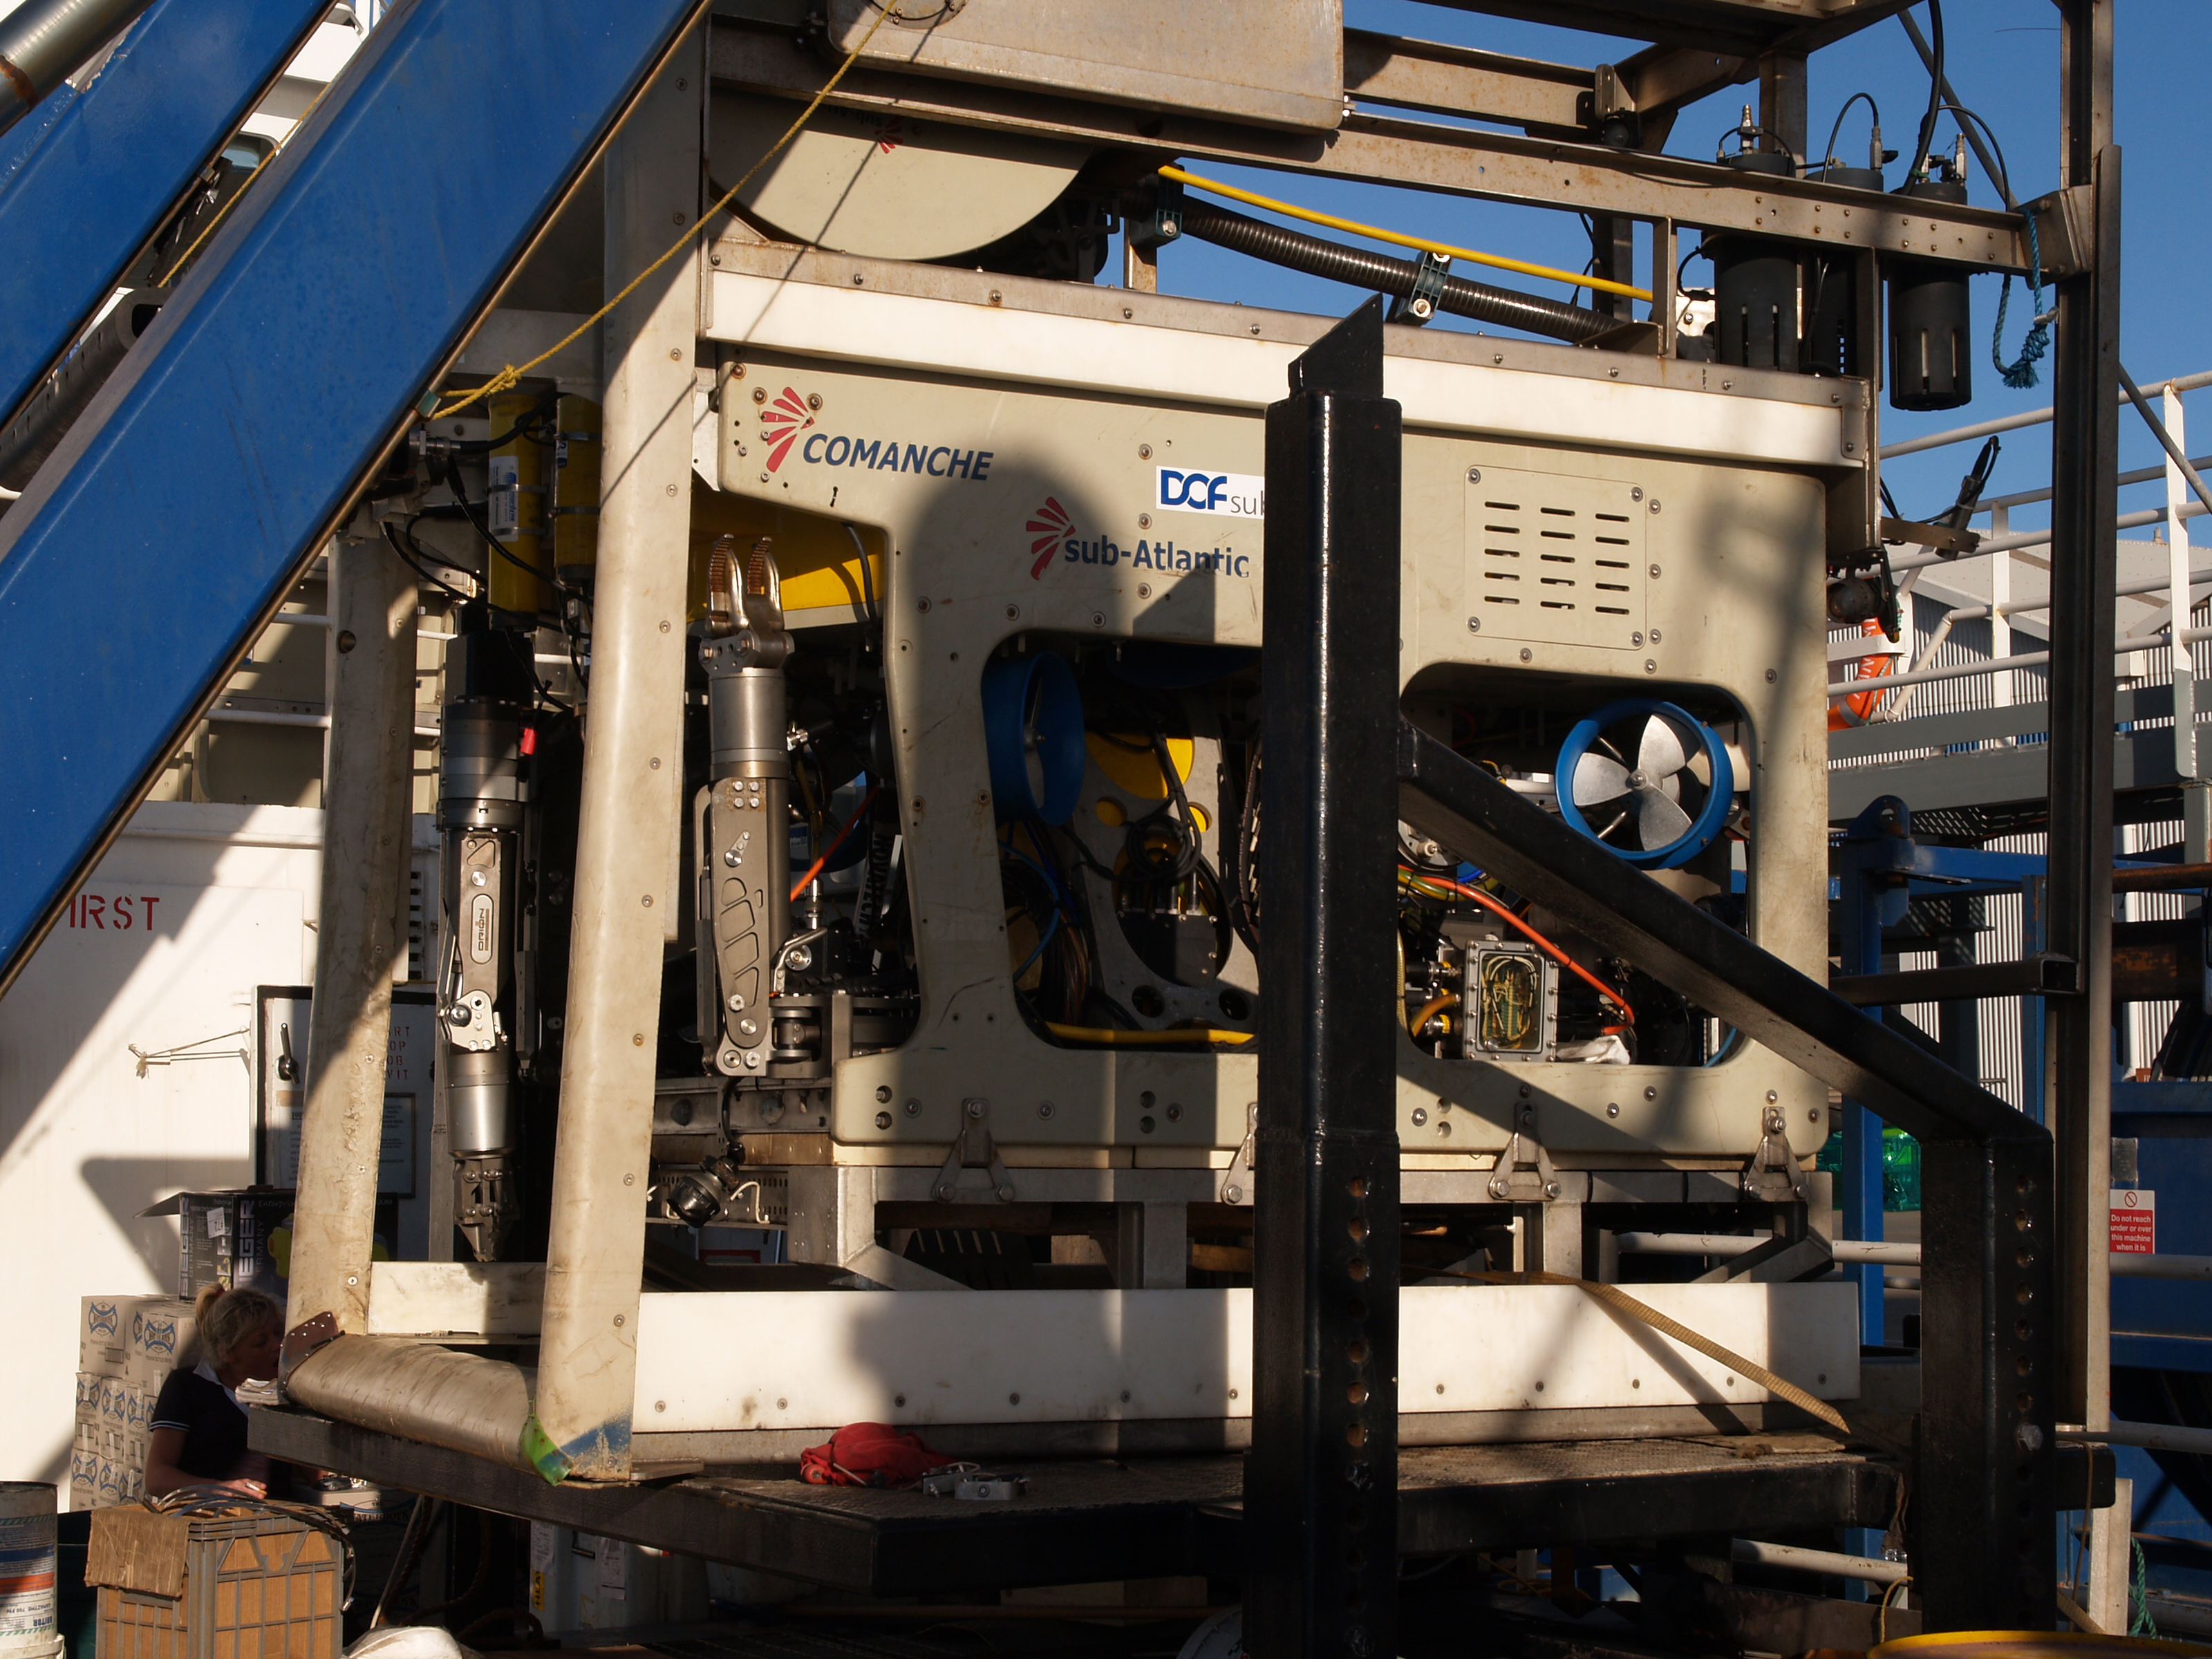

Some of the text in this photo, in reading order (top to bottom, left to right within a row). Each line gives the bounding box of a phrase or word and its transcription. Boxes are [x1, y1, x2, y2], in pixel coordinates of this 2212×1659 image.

[803, 433, 993, 481] COMANCHE
[1161, 469, 1228, 510] DCF
[1064, 534, 1250, 578] sub-Atlantic
[70, 894, 160, 930] IRST
[239, 1200, 254, 1282] IEGER
[256, 1220, 265, 1273] ERMANY
[354, 1509, 409, 1523] ATERBOYS
